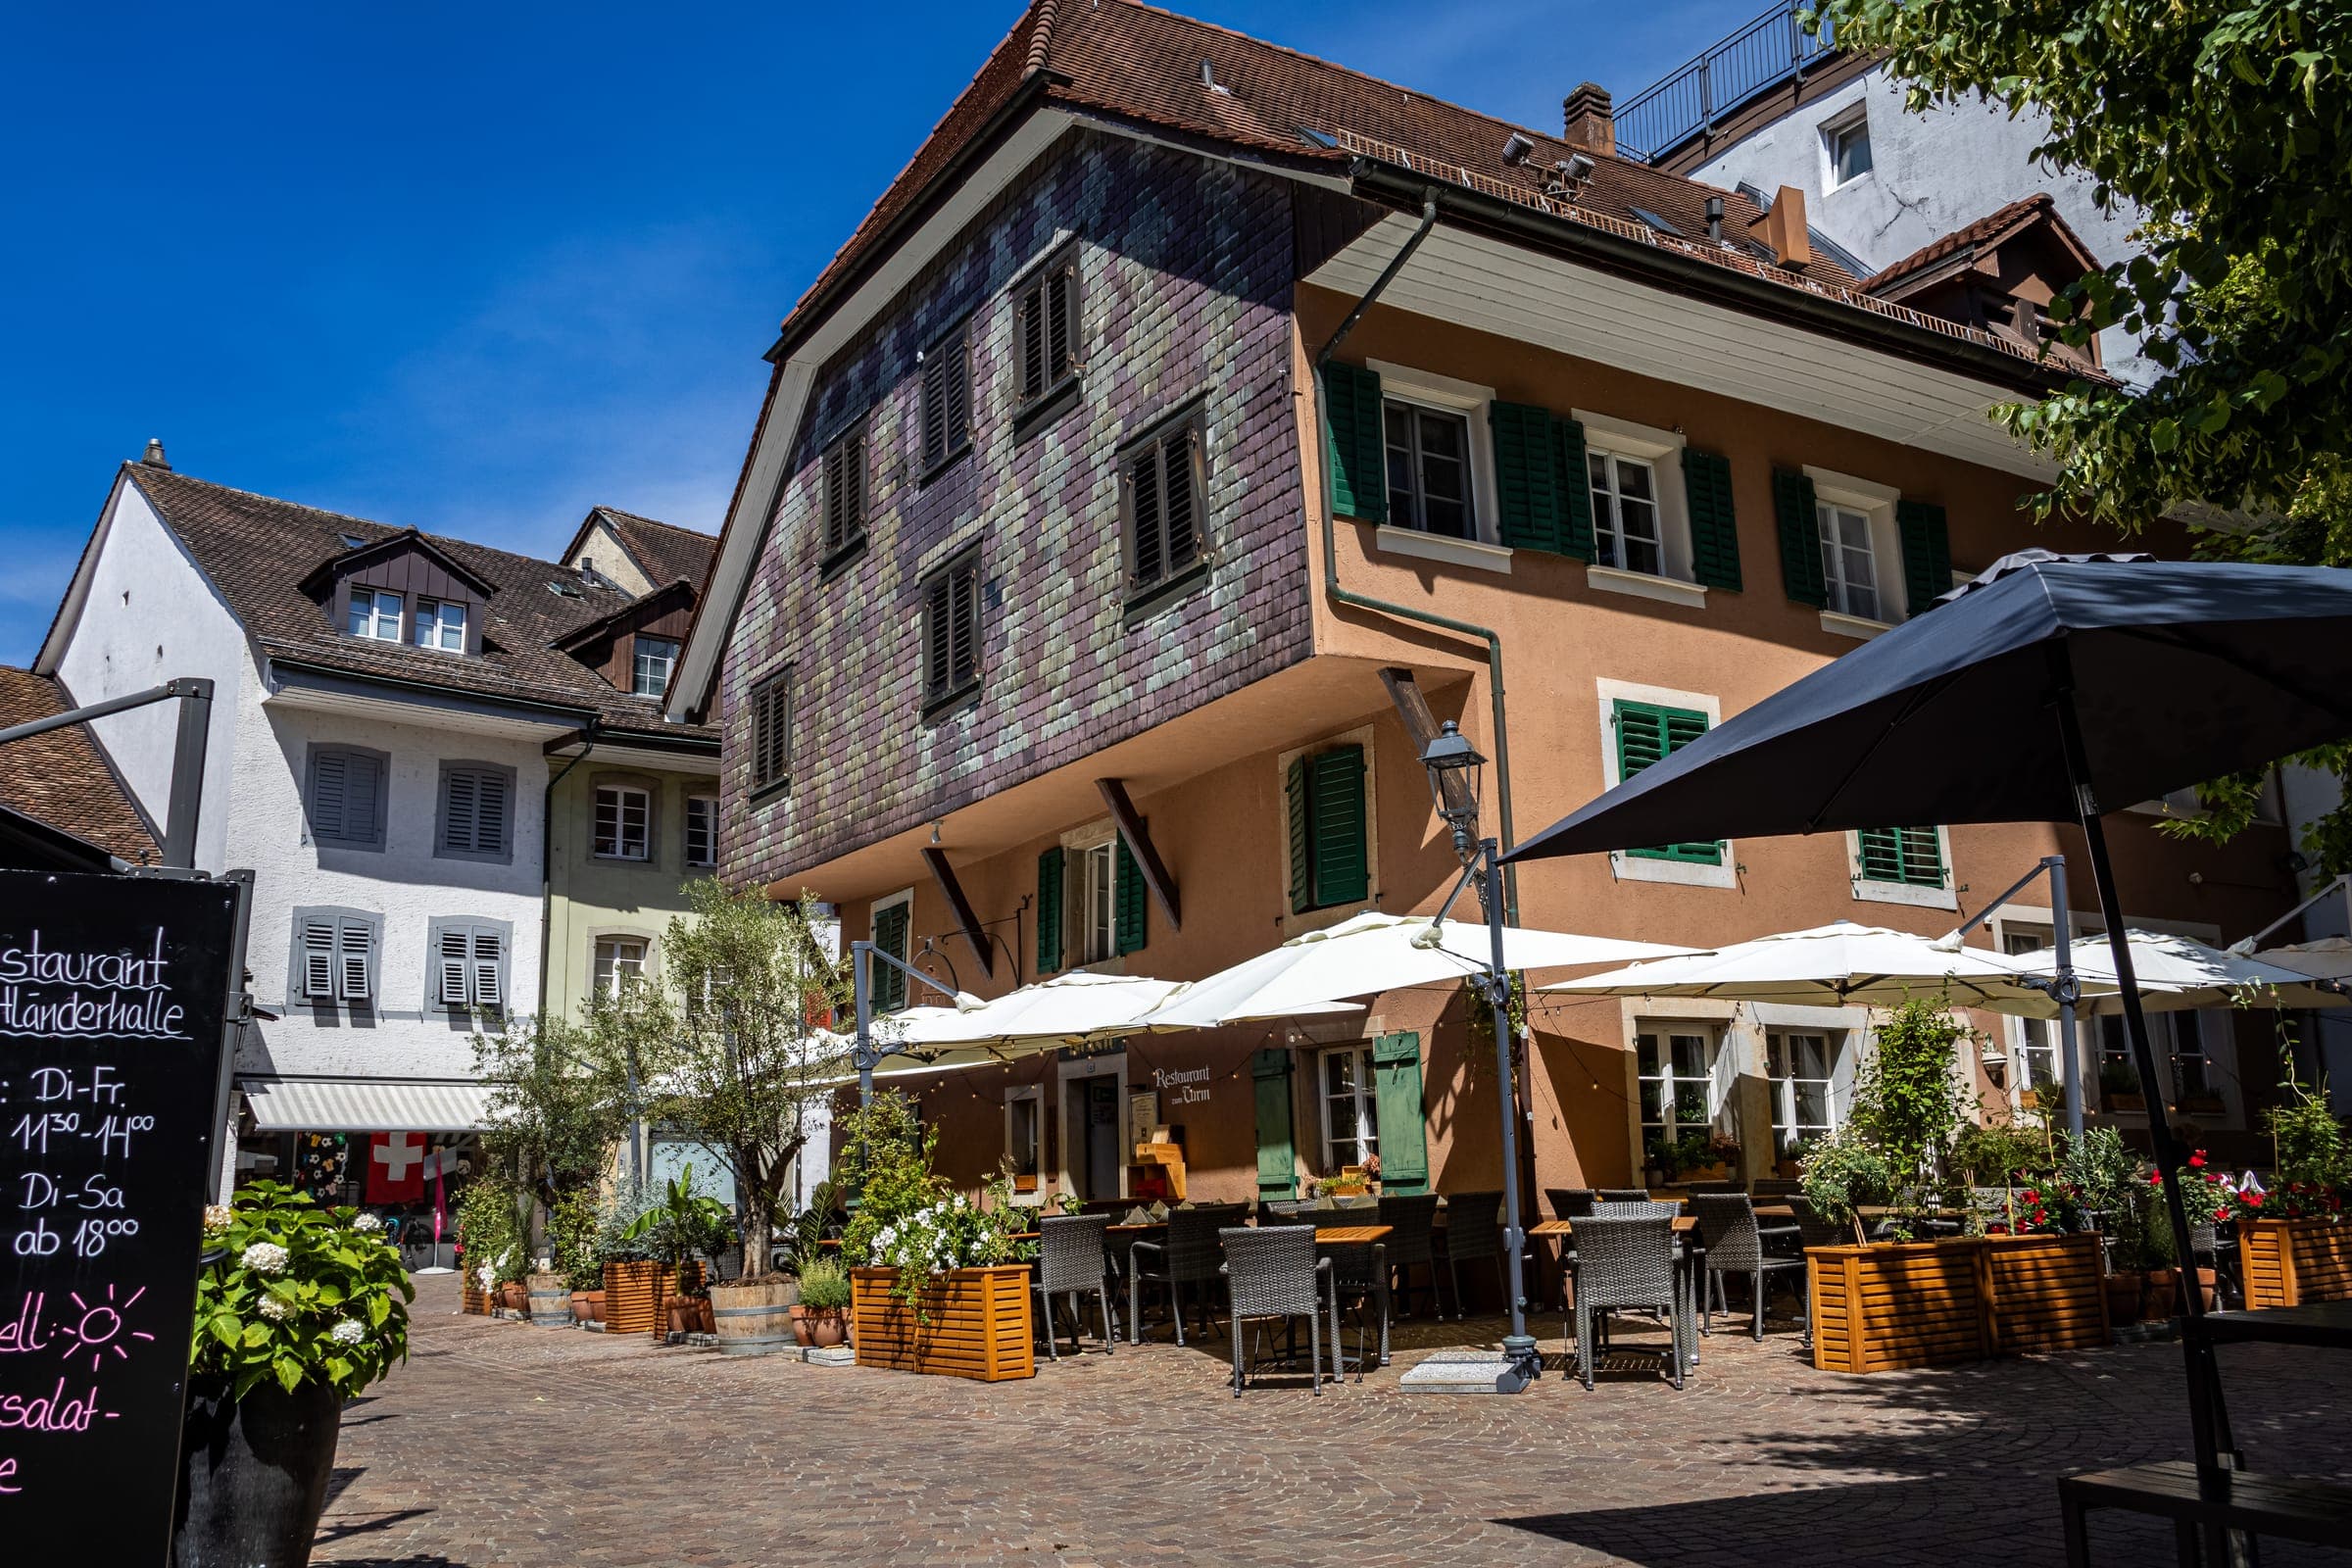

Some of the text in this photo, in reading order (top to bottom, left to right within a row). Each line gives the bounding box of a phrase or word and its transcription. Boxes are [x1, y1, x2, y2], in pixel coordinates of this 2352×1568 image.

[1154, 1064, 1210, 1089] Restaurant
[1182, 1084, 1210, 1104] Turm
[19, 1172, 126, 1208] Di-Sa
[15, 1217, 61, 1255] ab
[0, 1376, 121, 1432] salat-
